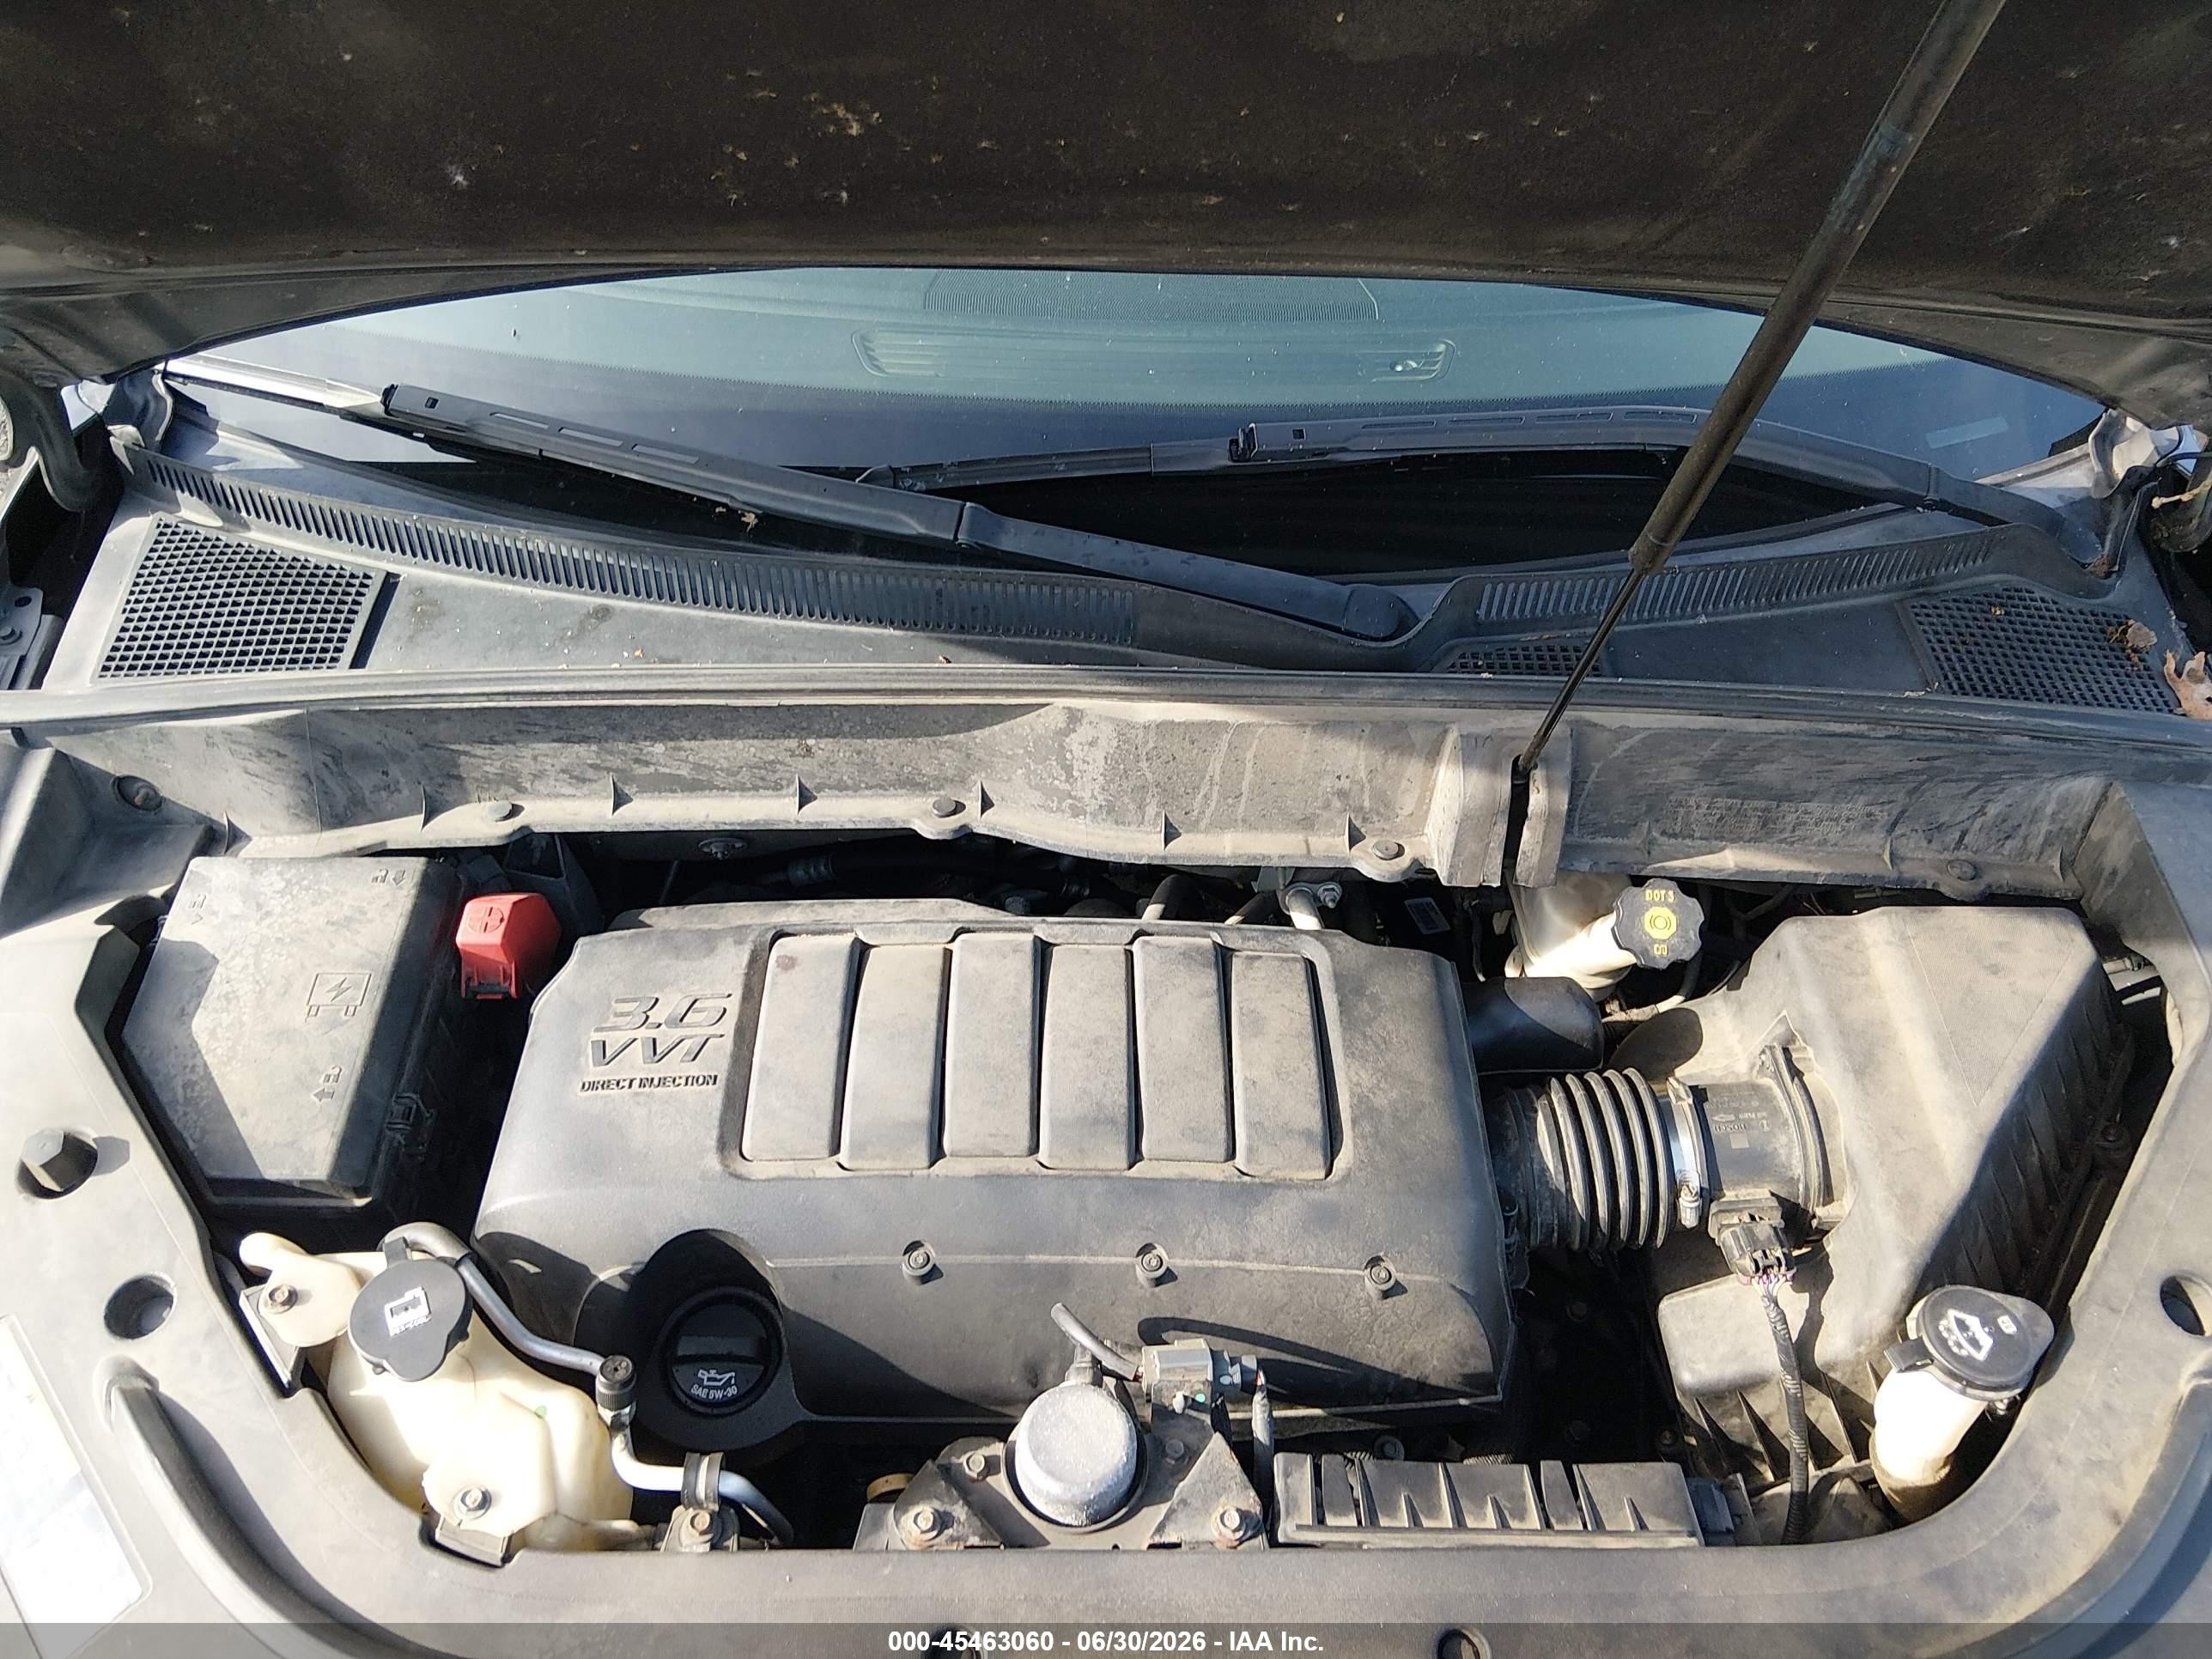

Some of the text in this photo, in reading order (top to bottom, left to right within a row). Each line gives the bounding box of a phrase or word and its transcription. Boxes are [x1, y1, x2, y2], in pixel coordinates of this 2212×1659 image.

[1645, 890, 1666, 902] DOT
[593, 993, 732, 1033] 3.6
[590, 1033, 725, 1067] VVT
[580, 1074, 719, 1092] DIRECT INJECTION
[1713, 1123, 1747, 1133] BOSCH
[690, 1384, 738, 1401] SAE 5W-30
